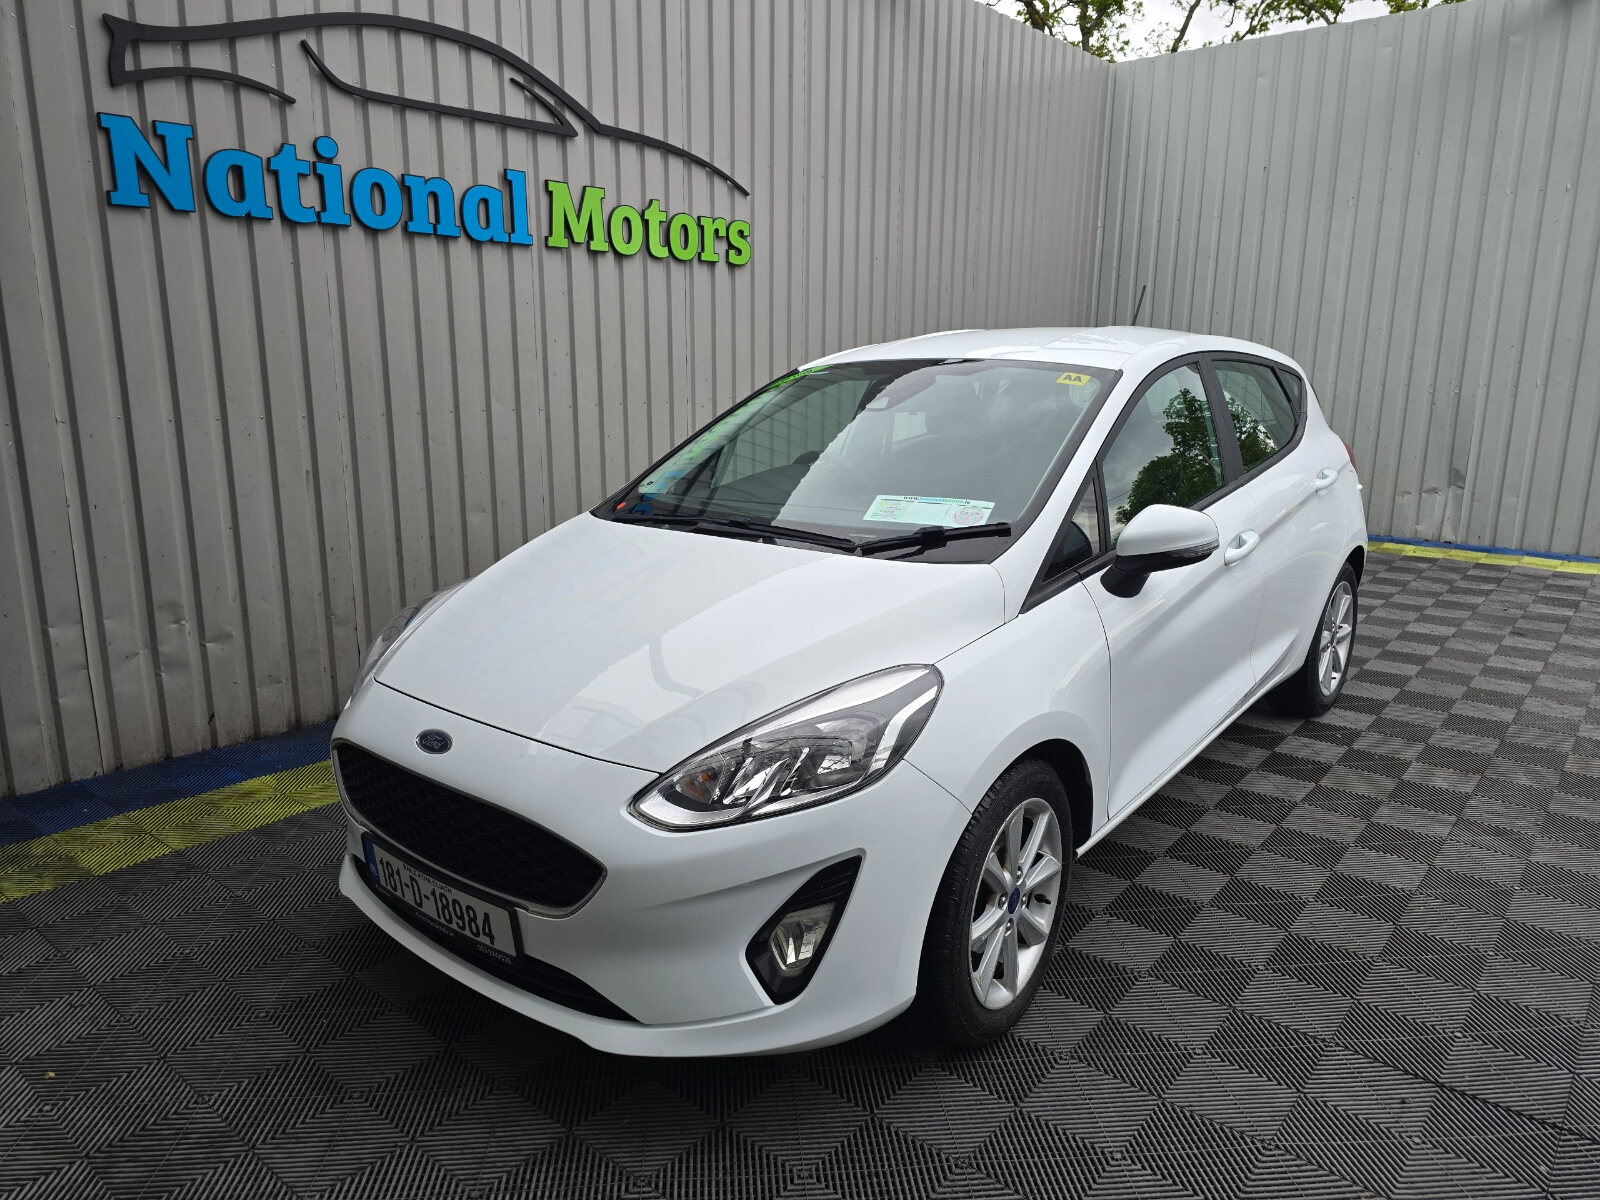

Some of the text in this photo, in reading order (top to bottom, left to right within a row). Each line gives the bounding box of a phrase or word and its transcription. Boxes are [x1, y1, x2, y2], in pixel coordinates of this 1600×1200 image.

[97, 112, 751, 266] National Motors
[1063, 374, 1082, 382] AA
[379, 857, 495, 946] 181-D-18984
